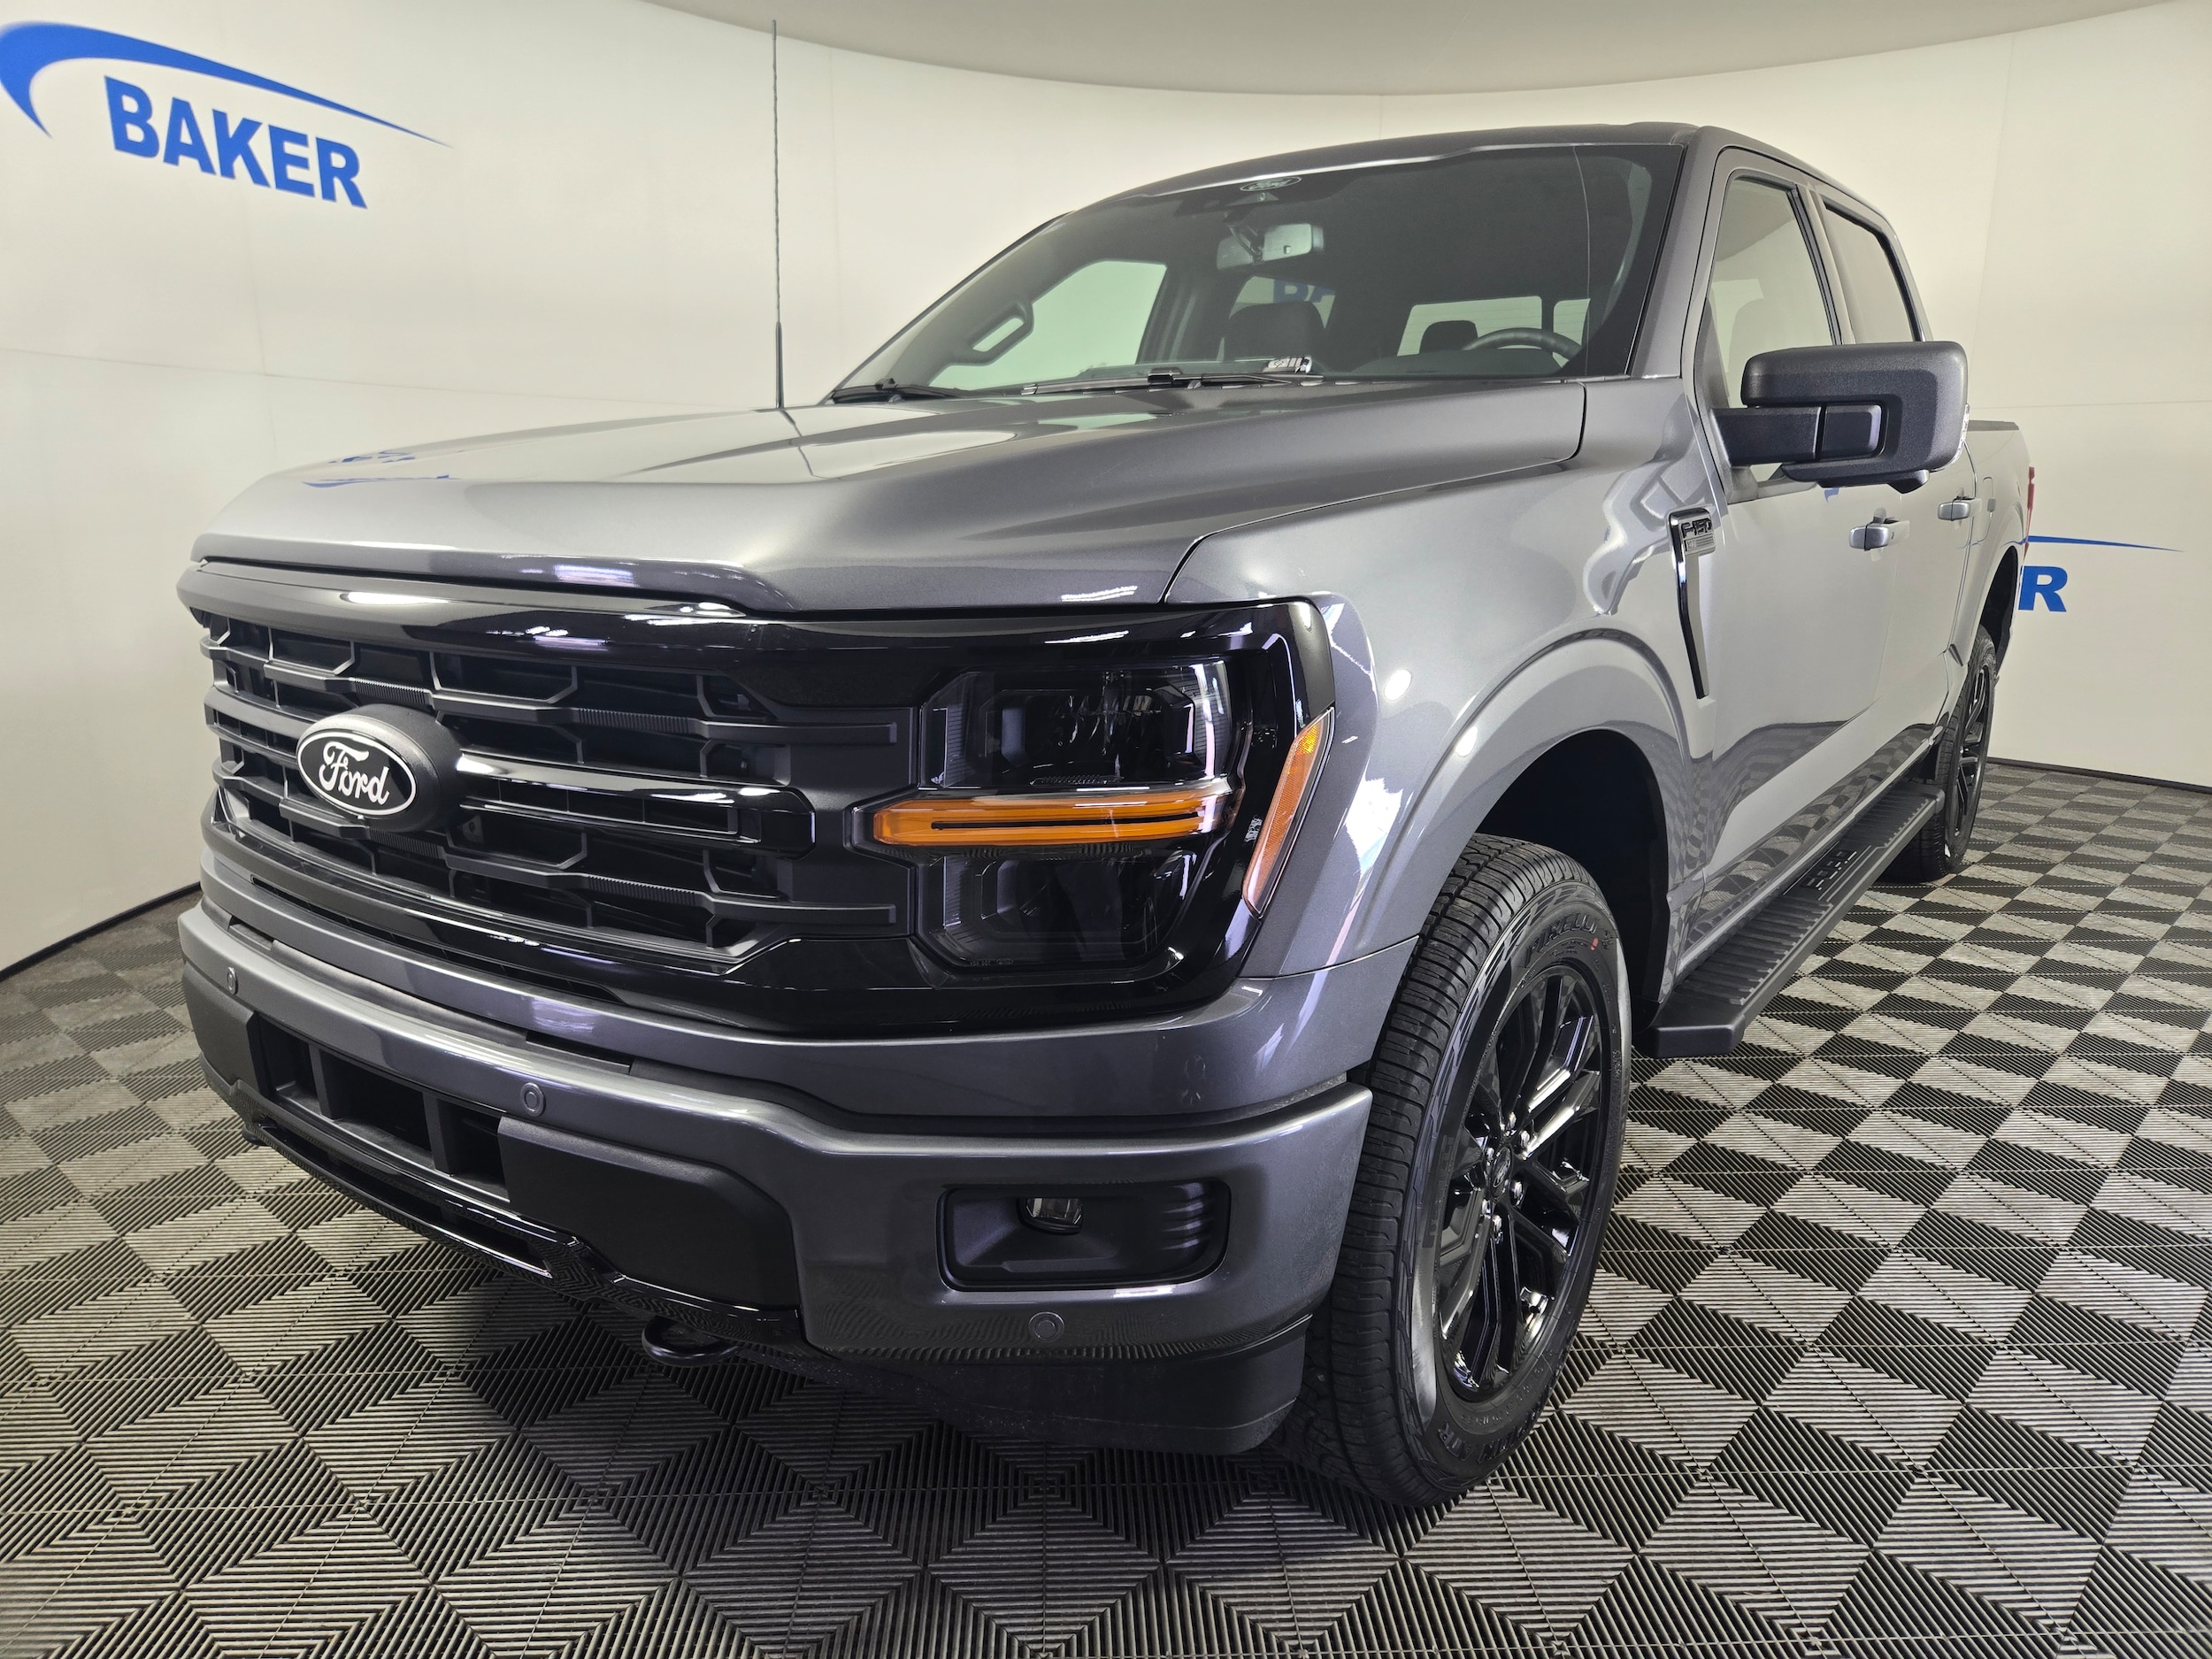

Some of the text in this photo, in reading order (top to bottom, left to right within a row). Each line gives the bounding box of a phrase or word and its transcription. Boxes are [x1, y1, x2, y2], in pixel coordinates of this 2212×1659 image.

[104, 75, 367, 209] BAKER
[1681, 518, 1712, 538] F-150
[319, 741, 390, 805] Ford
[1524, 913, 1599, 968] PIRELLI
